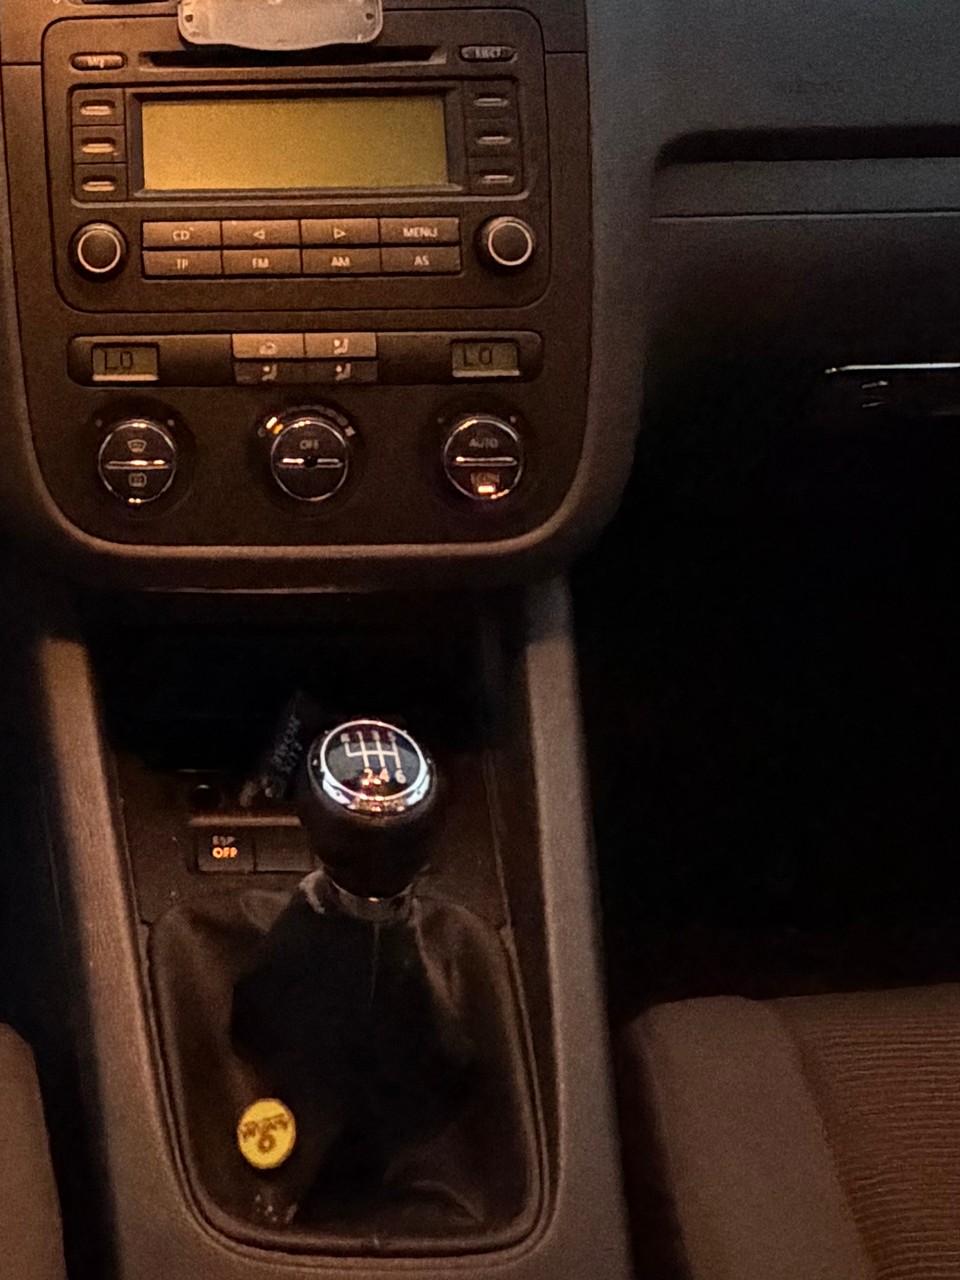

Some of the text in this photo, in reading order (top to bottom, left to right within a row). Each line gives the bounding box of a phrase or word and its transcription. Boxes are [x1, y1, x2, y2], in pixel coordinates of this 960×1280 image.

[172, 230, 190, 241] CD
[403, 227, 438, 238] MENU
[414, 255, 430, 266] AS
[395, 769, 407, 784] 6
[212, 846, 238, 859] OFF
